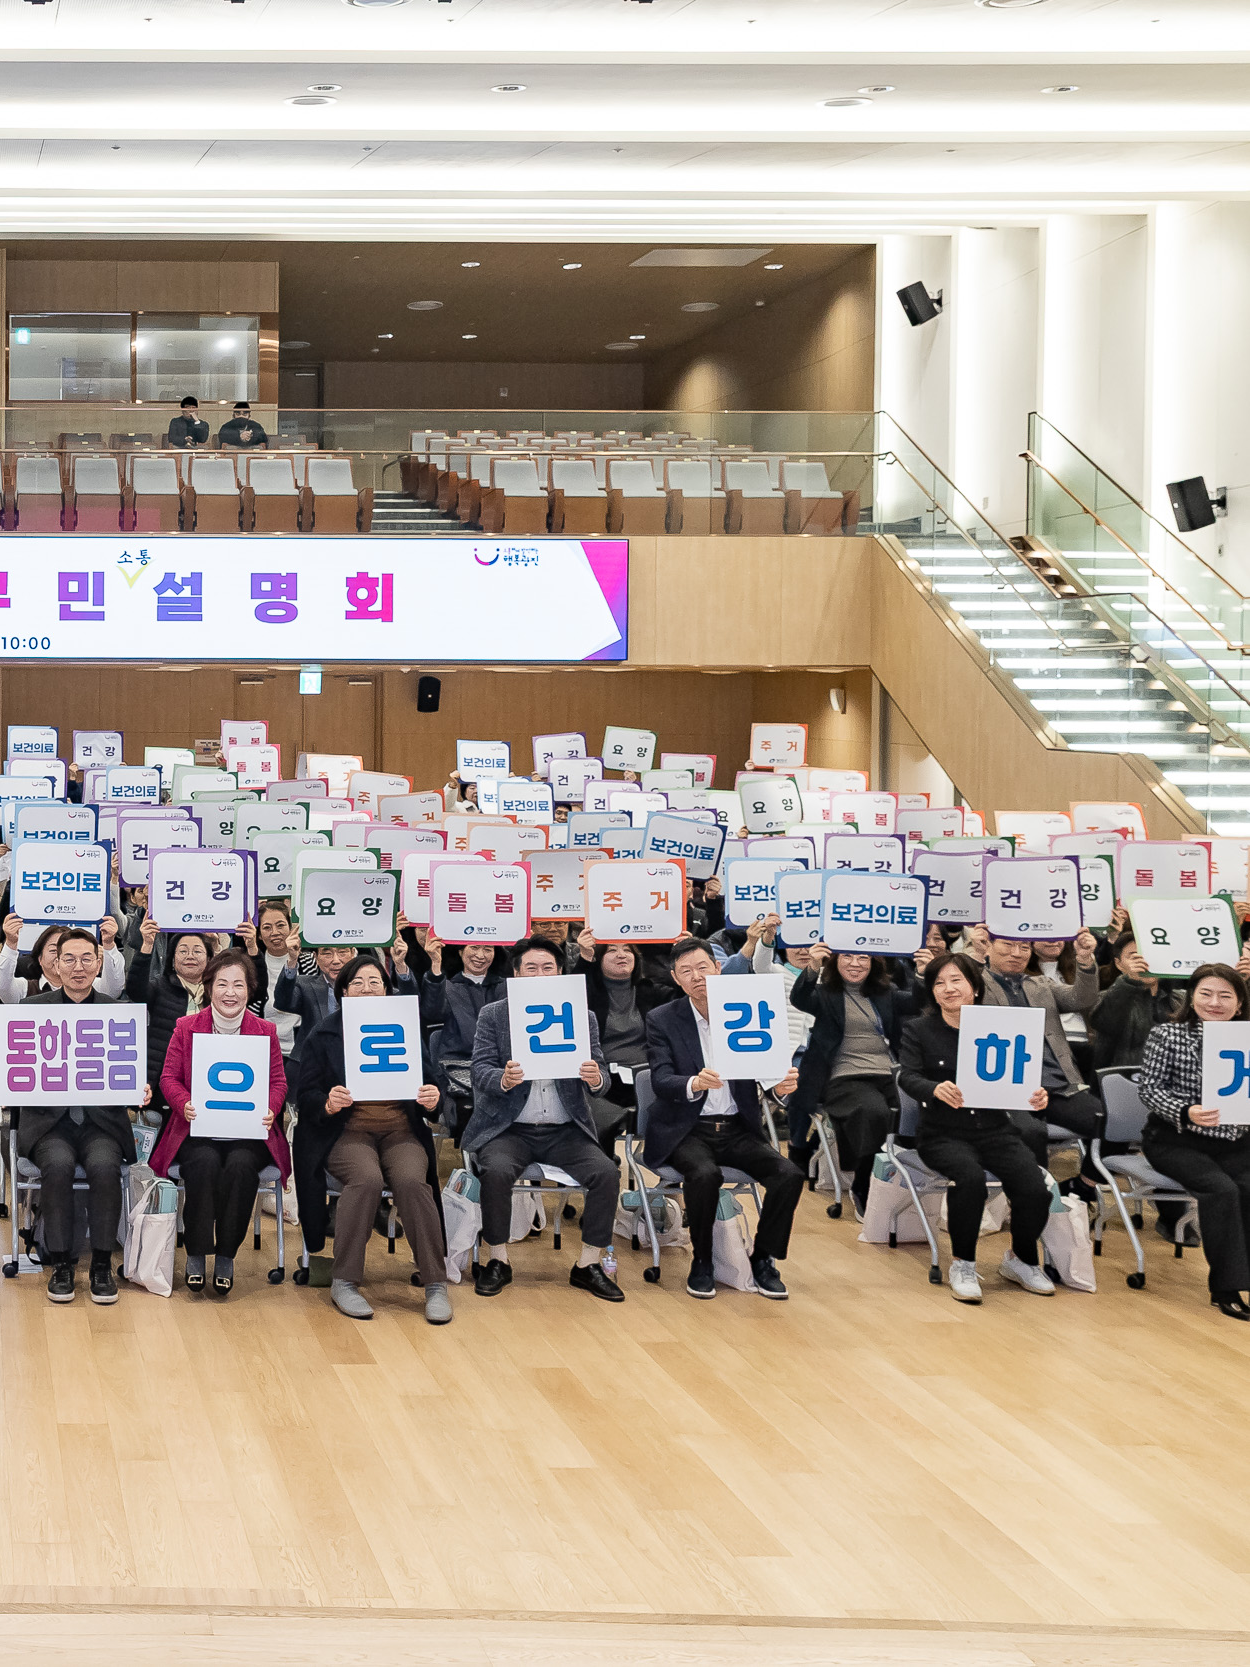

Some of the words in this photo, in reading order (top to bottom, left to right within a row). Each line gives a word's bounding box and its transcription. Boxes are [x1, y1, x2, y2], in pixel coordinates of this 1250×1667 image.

[116, 549, 152, 566] 소통
[1, 636, 51, 650] 10:00
[13, 743, 55, 754] 보건의료
[463, 757, 506, 768] 보건의료
[111, 785, 157, 798] 보건의료
[503, 800, 550, 811] 보건의료
[573, 833, 600, 845] 보건
[650, 836, 716, 861] 보건의료
[21, 871, 102, 892] 보건의료
[734, 885, 776, 901] 보건
[786, 900, 821, 918] 보건
[831, 903, 918, 925] 보건의료
[525, 1001, 577, 1054] 건
[723, 1000, 776, 1052] 강
[6, 1017, 138, 1092] 통합돌봄
[359, 1023, 410, 1073] 로
[974, 1033, 1032, 1084] 하
[204, 1061, 256, 1111] 으
